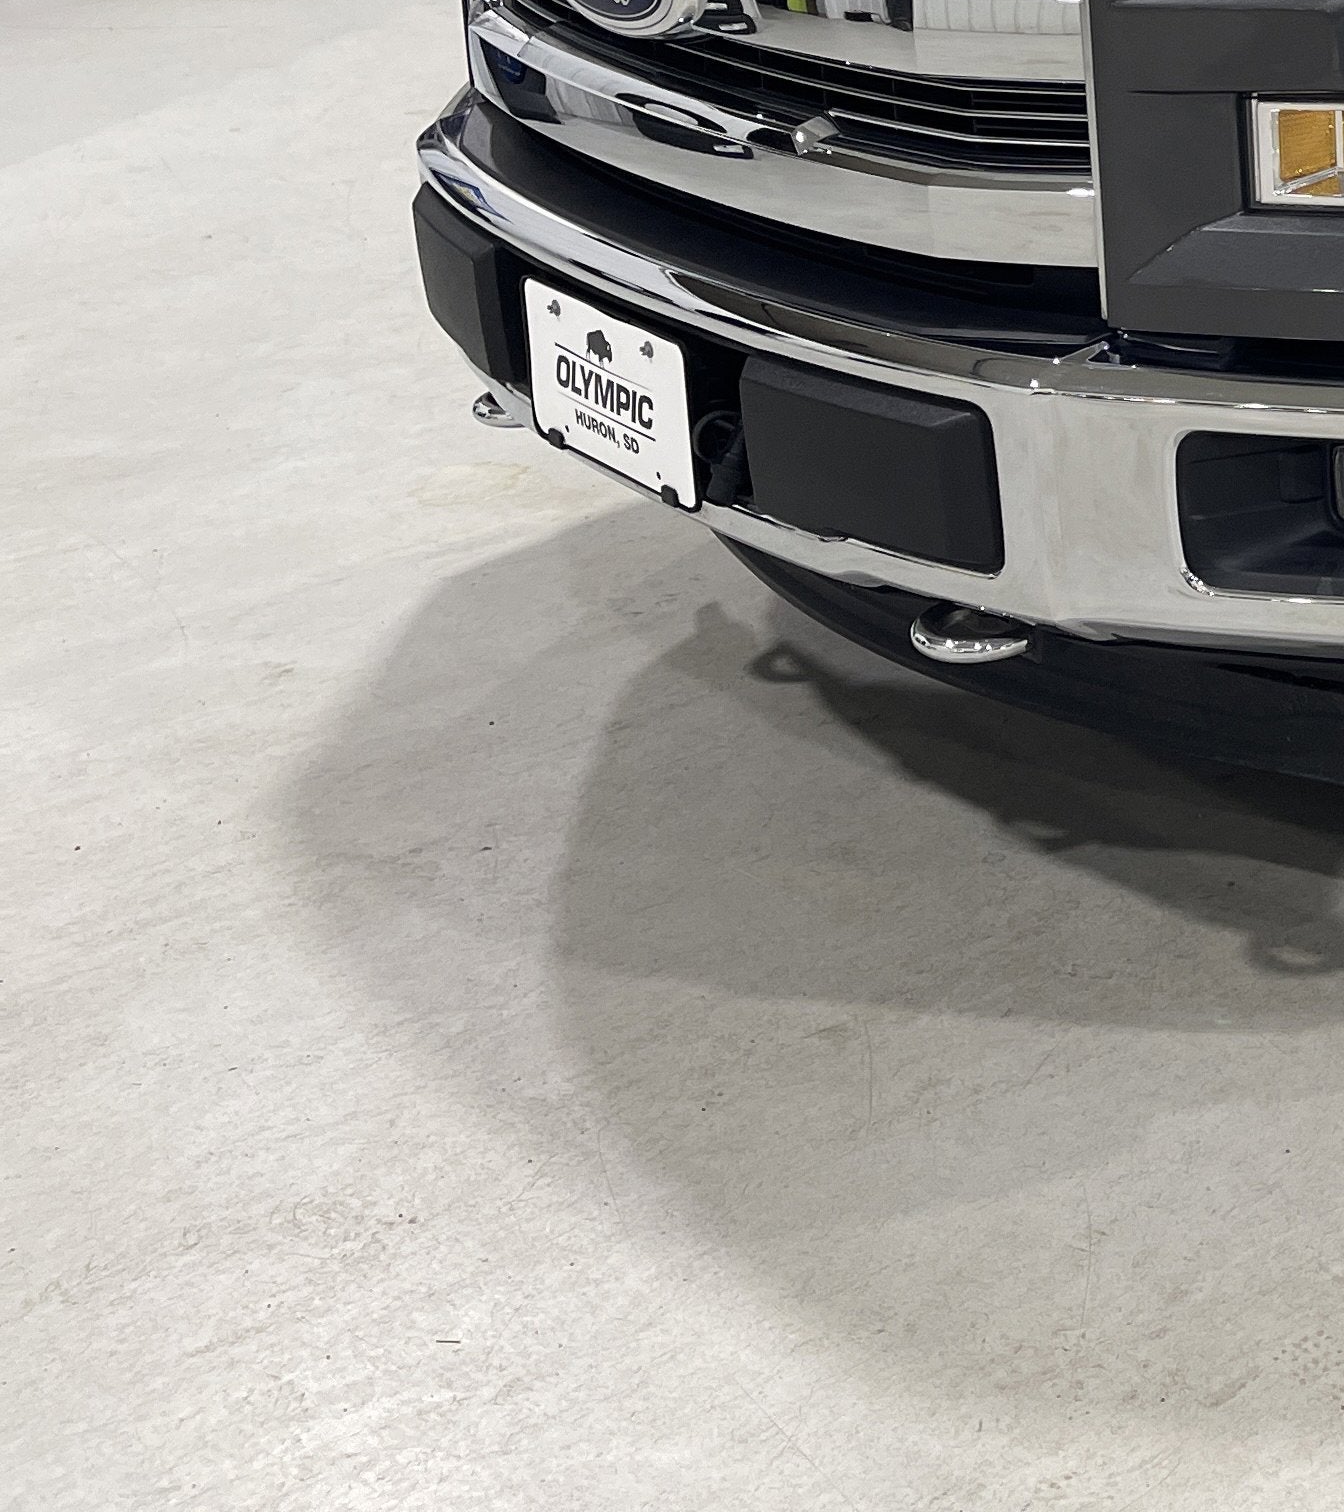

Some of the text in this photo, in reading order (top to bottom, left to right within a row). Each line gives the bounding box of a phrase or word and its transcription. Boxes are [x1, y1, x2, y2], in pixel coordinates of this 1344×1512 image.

[556, 354, 654, 430] OLYMPIC
[575, 408, 640, 455] HURON, SD
